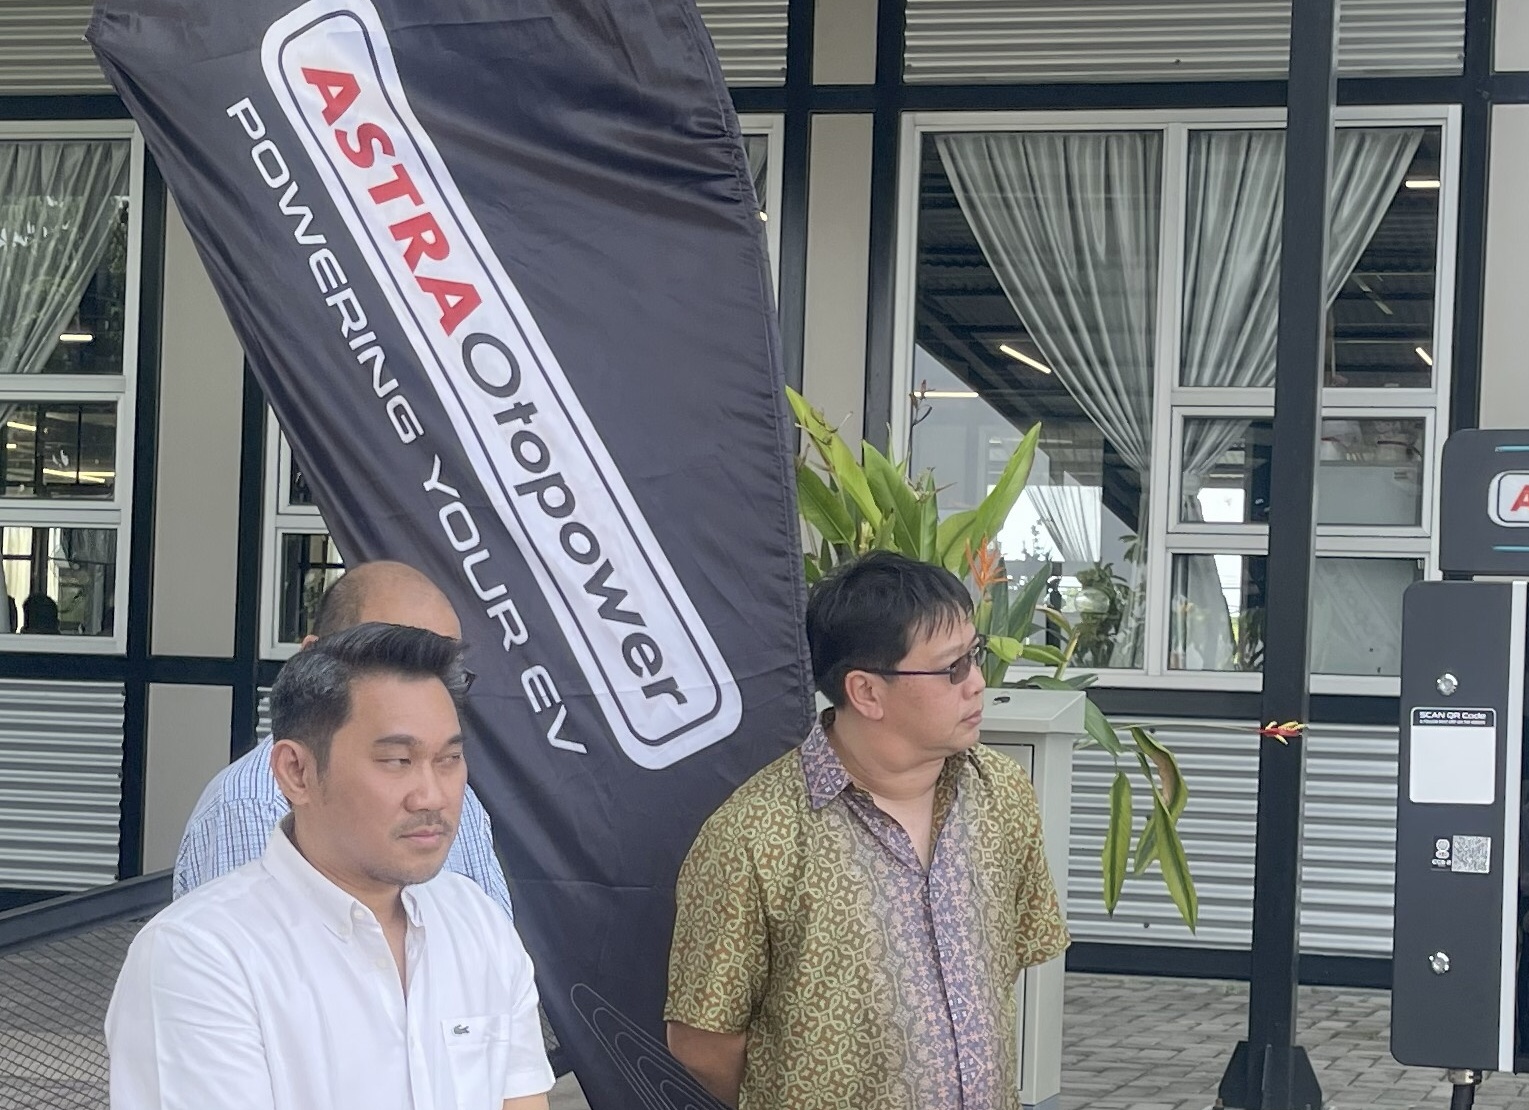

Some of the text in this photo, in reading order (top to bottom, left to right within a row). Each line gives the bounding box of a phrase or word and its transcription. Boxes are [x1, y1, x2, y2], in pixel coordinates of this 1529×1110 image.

[227, 97, 588, 755] POWERING YOUR EV
[302, 66, 688, 706] ASTRAOtopower
